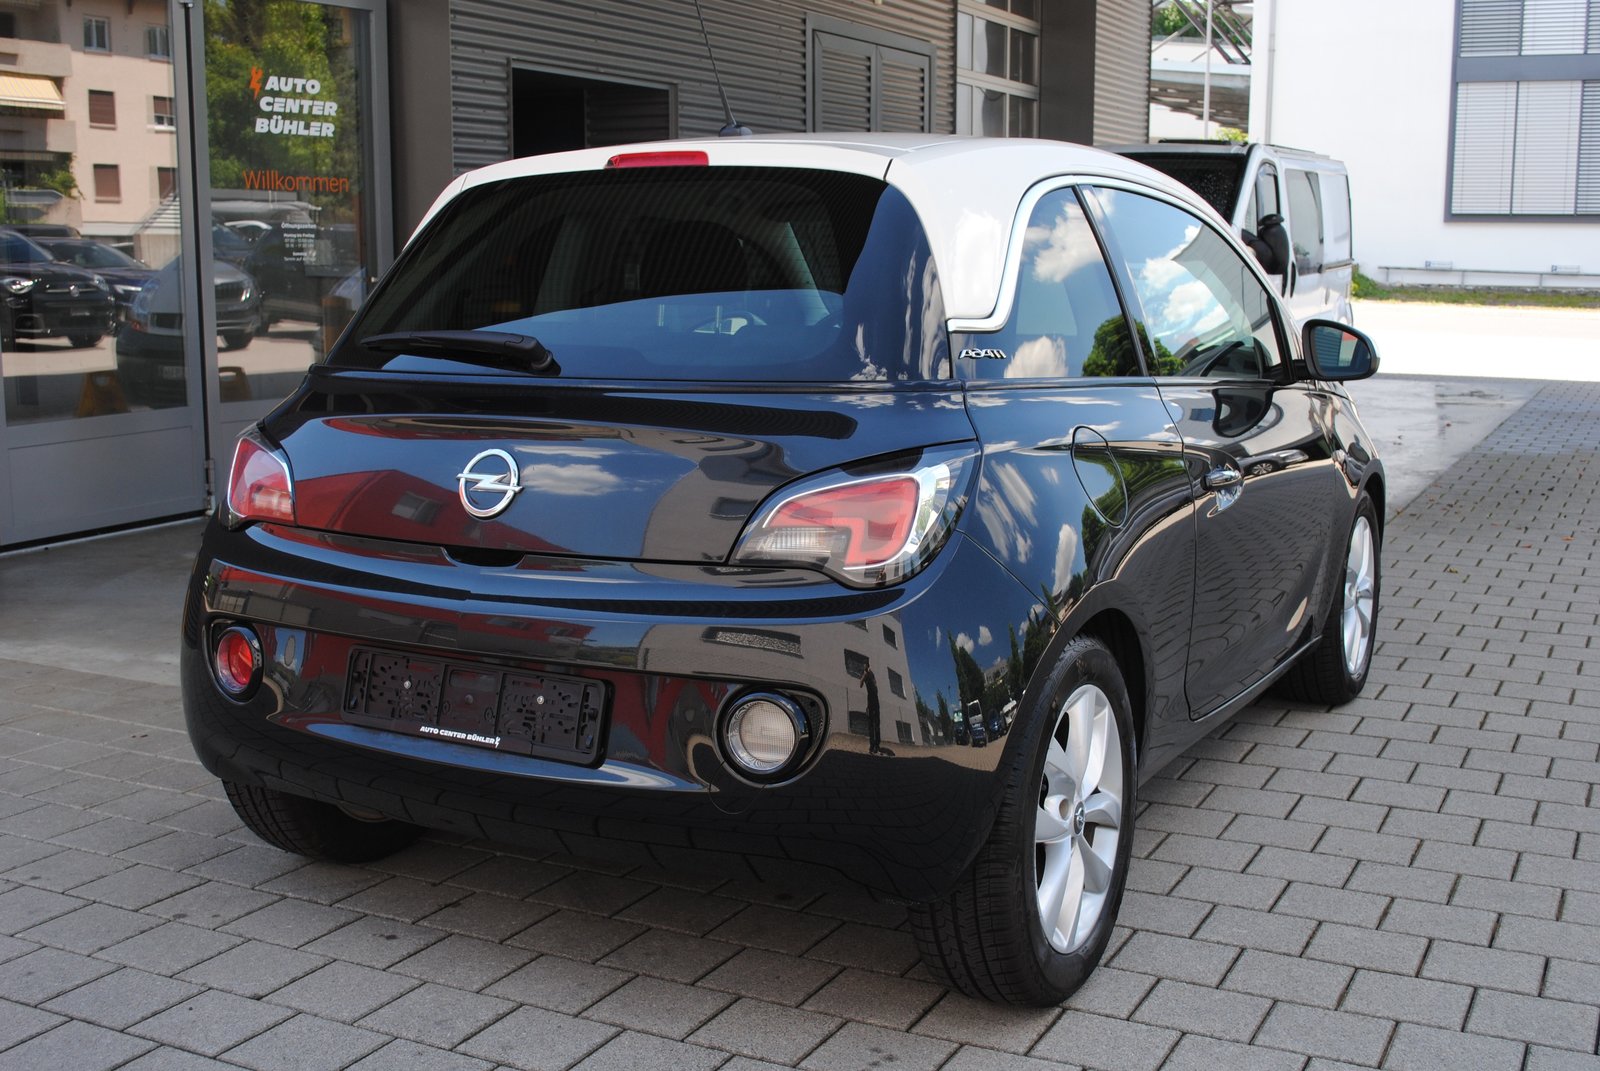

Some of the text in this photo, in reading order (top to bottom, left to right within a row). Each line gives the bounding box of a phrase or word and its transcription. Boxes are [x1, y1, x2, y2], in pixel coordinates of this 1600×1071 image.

[265, 76, 321, 95] AUTO
[259, 96, 338, 117] CENTER
[255, 115, 335, 137] BÜHLER
[242, 169, 349, 193] Willkommen
[420, 726, 495, 744] AUTO CENTER BÜHLER
